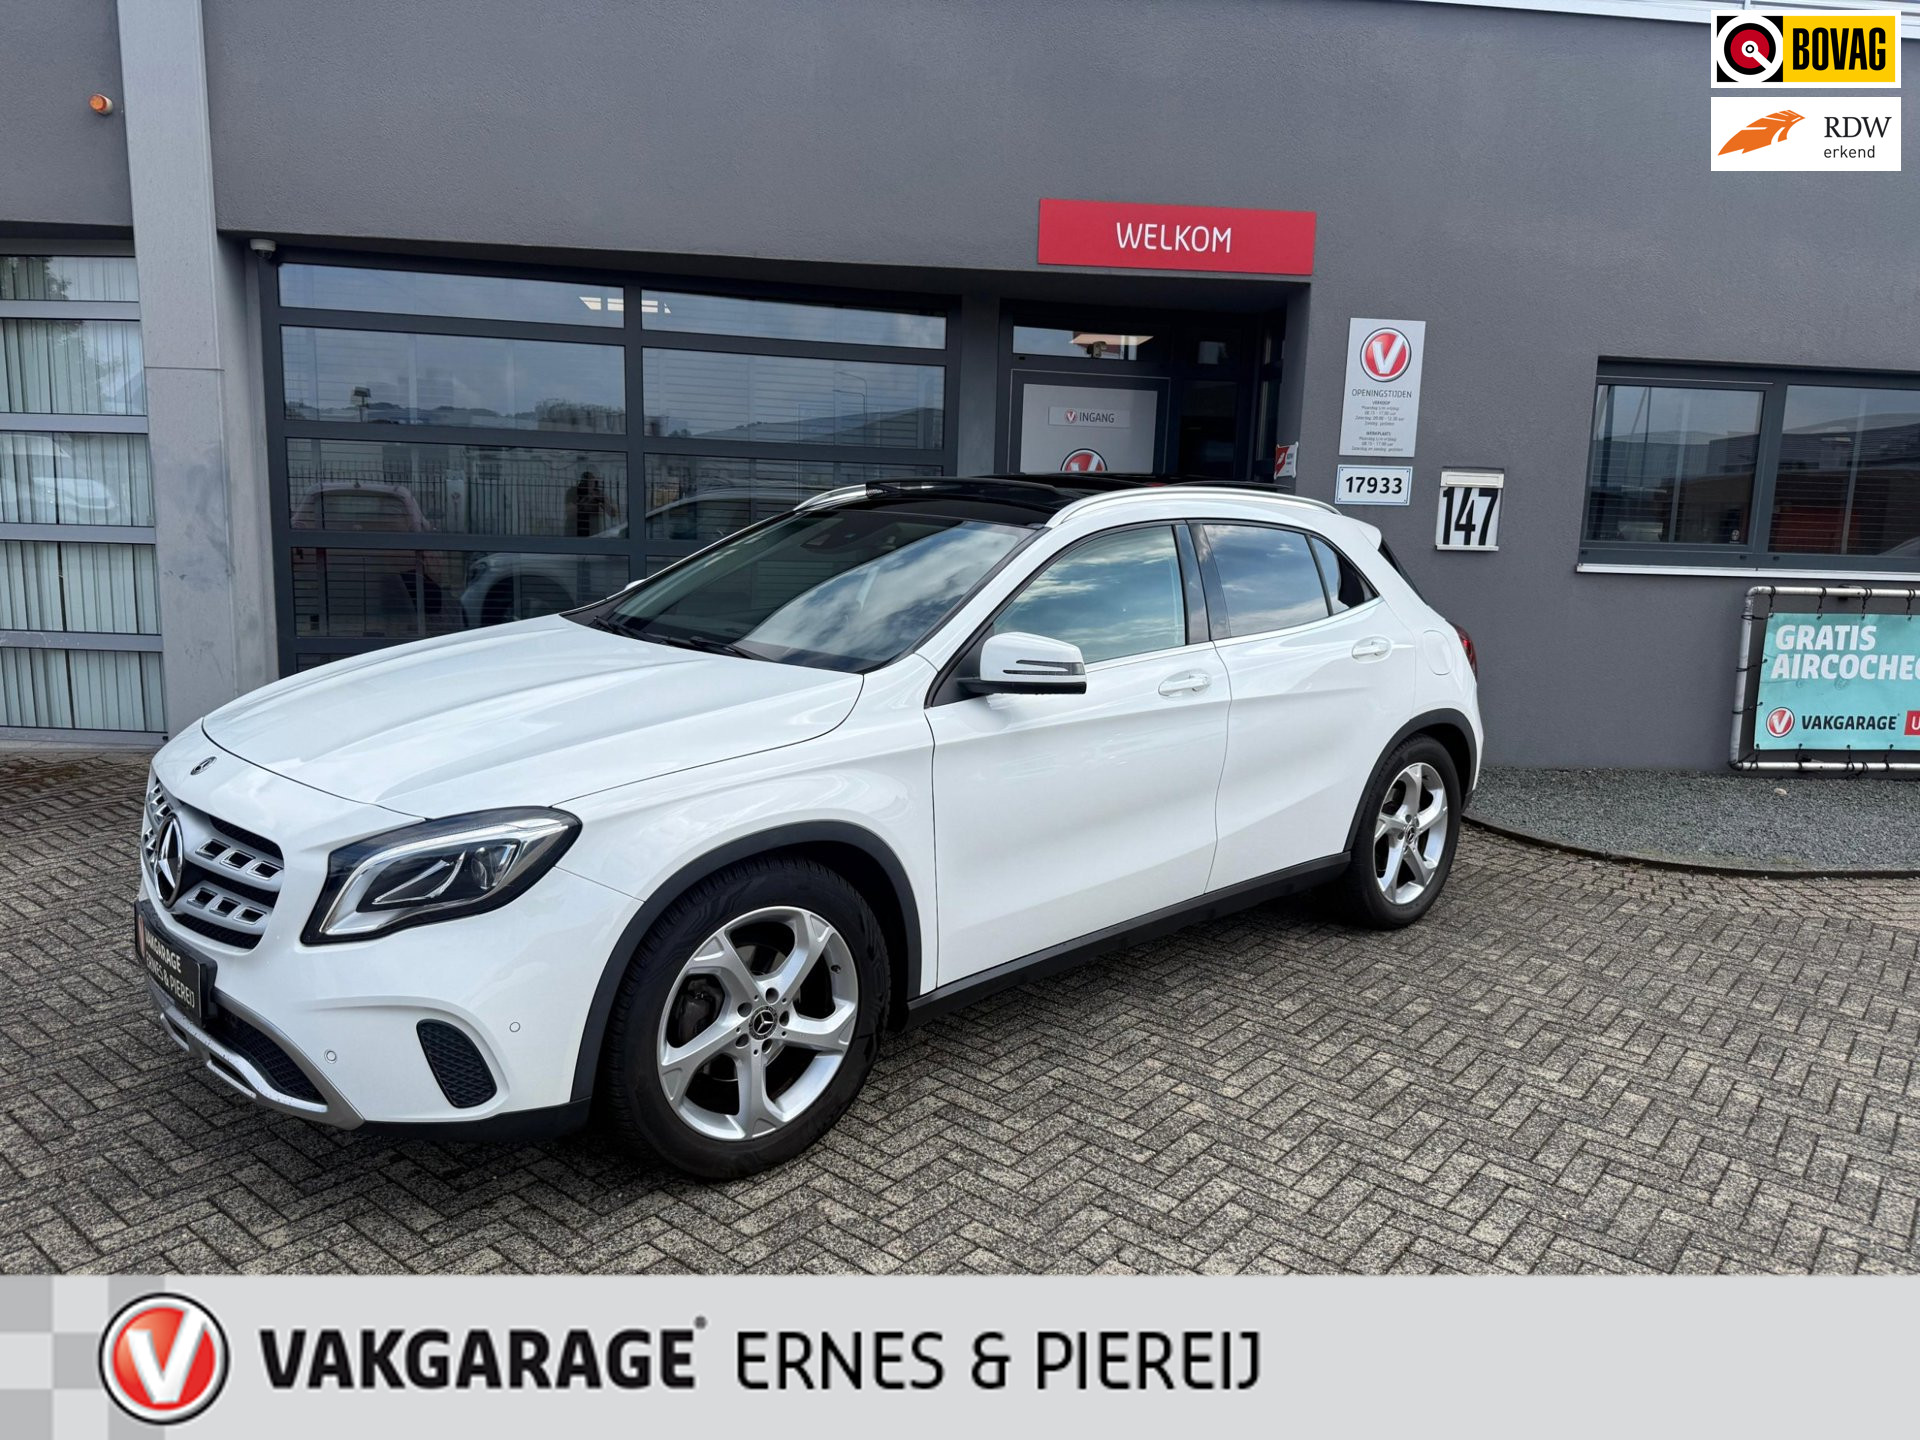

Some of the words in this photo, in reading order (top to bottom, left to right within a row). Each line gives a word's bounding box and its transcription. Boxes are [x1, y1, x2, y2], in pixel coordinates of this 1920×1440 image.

[1116, 222, 1232, 253] WELKOM
[1351, 388, 1412, 399] OPENINGSTIJDEN
[1079, 411, 1115, 424] INGANG
[1345, 476, 1403, 495] 17933
[1442, 487, 1499, 546] 147
[1775, 624, 1877, 651] GRATIS
[1801, 714, 1897, 730] VAKGARAGE
